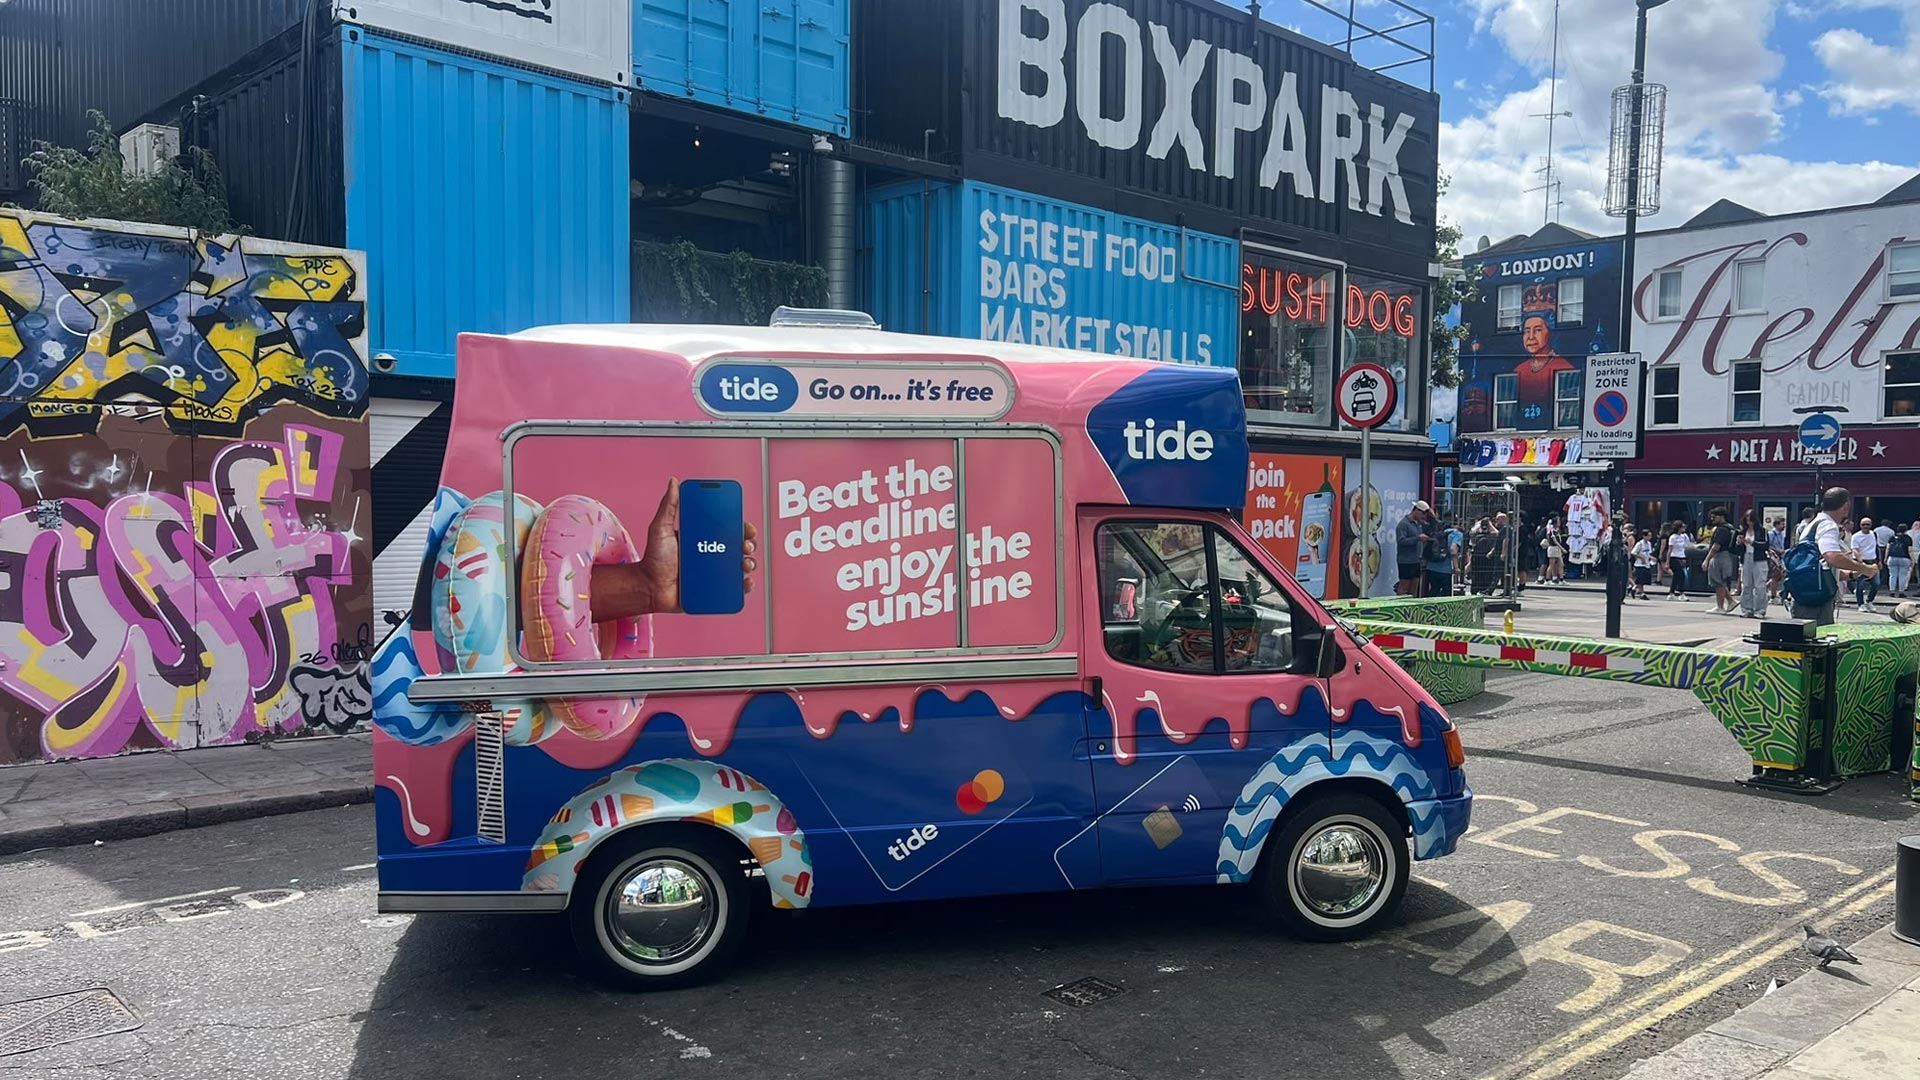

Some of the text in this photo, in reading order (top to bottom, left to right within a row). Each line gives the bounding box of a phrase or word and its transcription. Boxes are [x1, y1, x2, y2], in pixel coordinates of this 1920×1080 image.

[998, 0, 1415, 226] BOXPARK
[979, 208, 1176, 283] STREET FOOD
[301, 259, 338, 275] PPE
[980, 256, 1066, 309] BARS
[1347, 284, 1414, 337] DOG
[980, 302, 1212, 367] MARKET STALLS
[1591, 357, 1636, 367] Restricted
[1596, 368, 1629, 377] parking
[719, 376, 779, 401] tide
[809, 378, 993, 401] Go on... it's free
[1595, 378, 1628, 388] ZONE
[1786, 380, 1850, 405] CAMDEN
[31, 404, 89, 414] MONGO
[1123, 418, 1214, 461] tide
[1601, 430, 1633, 439] loading
[1730, 439, 1769, 462] PRET
[1773, 439, 1784, 461] A
[778, 459, 953, 518] Beat the
[1249, 461, 1285, 491] join
[1256, 494, 1276, 509] the
[784, 499, 955, 557] deadline
[1252, 515, 1295, 539] pack
[697, 541, 726, 553] tide
[836, 525, 1032, 595] enjoy the
[846, 567, 1032, 631] sunshine
[888, 824, 939, 861] tide
